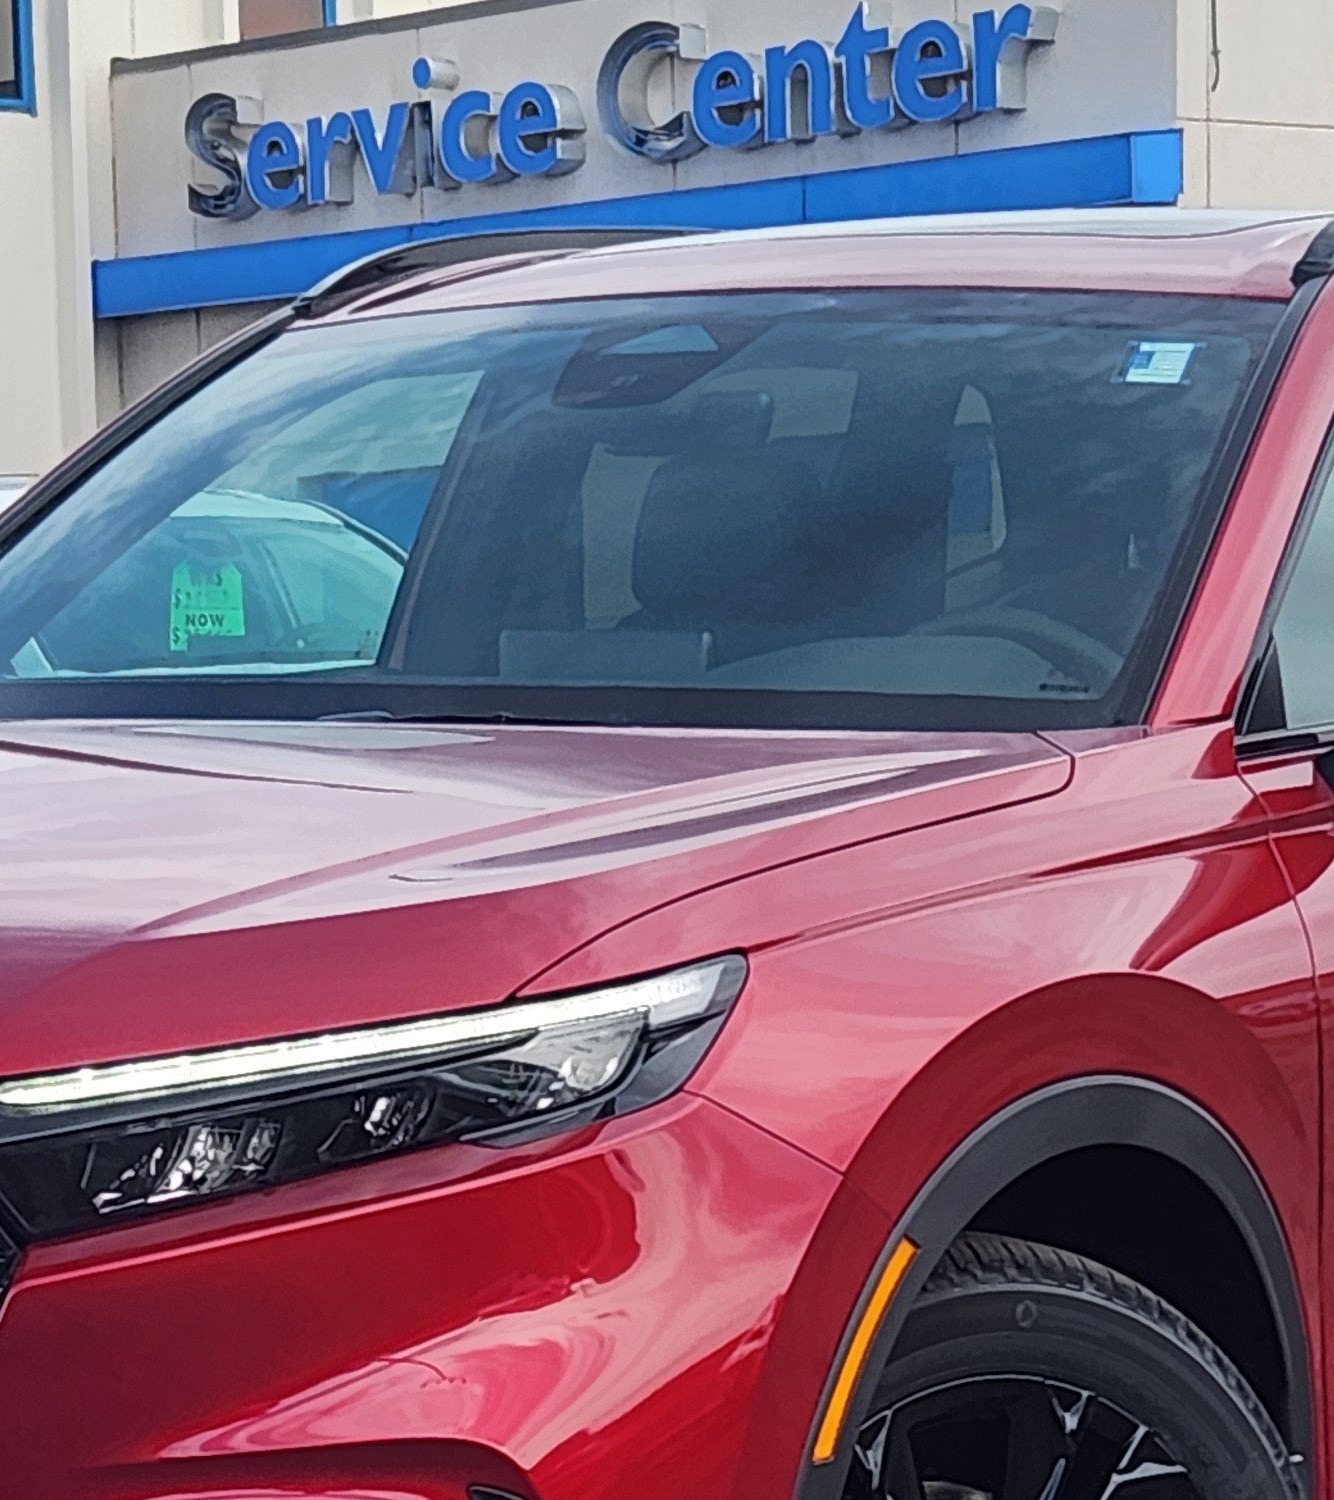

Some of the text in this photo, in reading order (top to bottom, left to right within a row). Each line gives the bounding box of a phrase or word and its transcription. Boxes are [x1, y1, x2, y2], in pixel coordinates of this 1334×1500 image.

[185, 2, 1055, 219] Service Center
[185, 613, 226, 628] NOW
